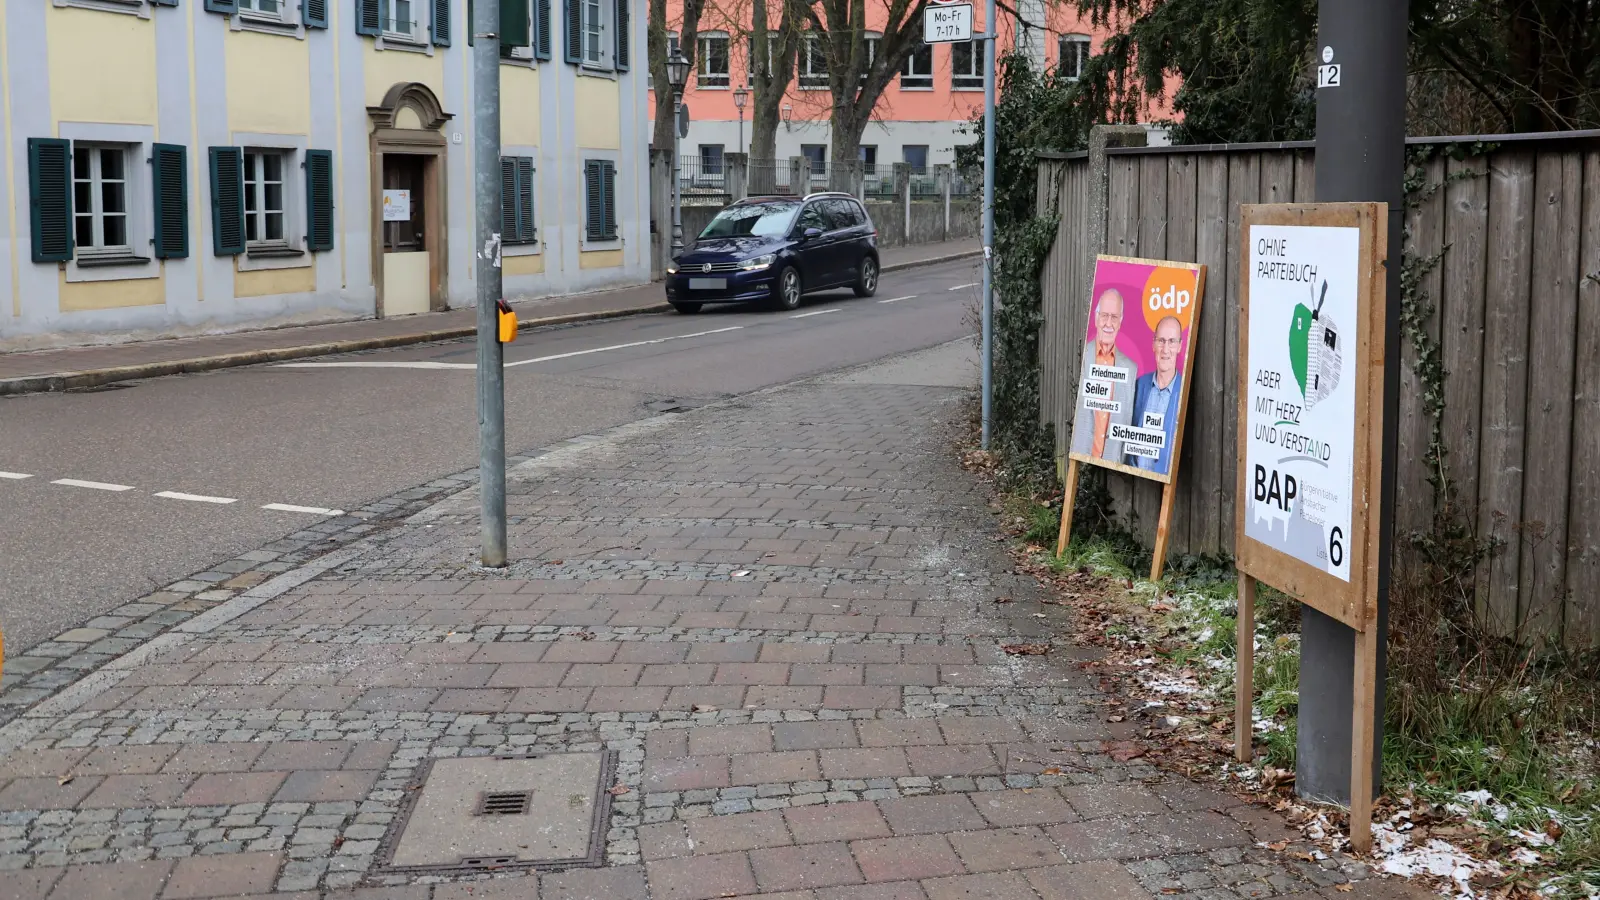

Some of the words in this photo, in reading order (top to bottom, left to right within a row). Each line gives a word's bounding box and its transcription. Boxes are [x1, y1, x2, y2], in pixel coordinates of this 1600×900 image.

[935, 10, 961, 22] Mo-Fr
[1319, 66, 1338, 85] 12
[1258, 238, 1286, 257] OHNE
[1258, 261, 1317, 283] PARTEIBUCH
[1149, 285, 1190, 313] ödp
[1091, 367, 1125, 380] Friedmann
[1256, 369, 1281, 390] ABER
[1085, 383, 1108, 396] Seiler
[1086, 400, 1114, 410] Listenplatz
[1255, 396, 1274, 415] MIT
[1276, 402, 1302, 424] HERZ
[1146, 415, 1161, 426] Paul
[1112, 426, 1162, 444] Sichermann
[1255, 423, 1277, 444] UND
[1280, 430, 1330, 461] VERSTAND
[1127, 446, 1153, 456] Listenplatz
[1330, 526, 1343, 566] 6
